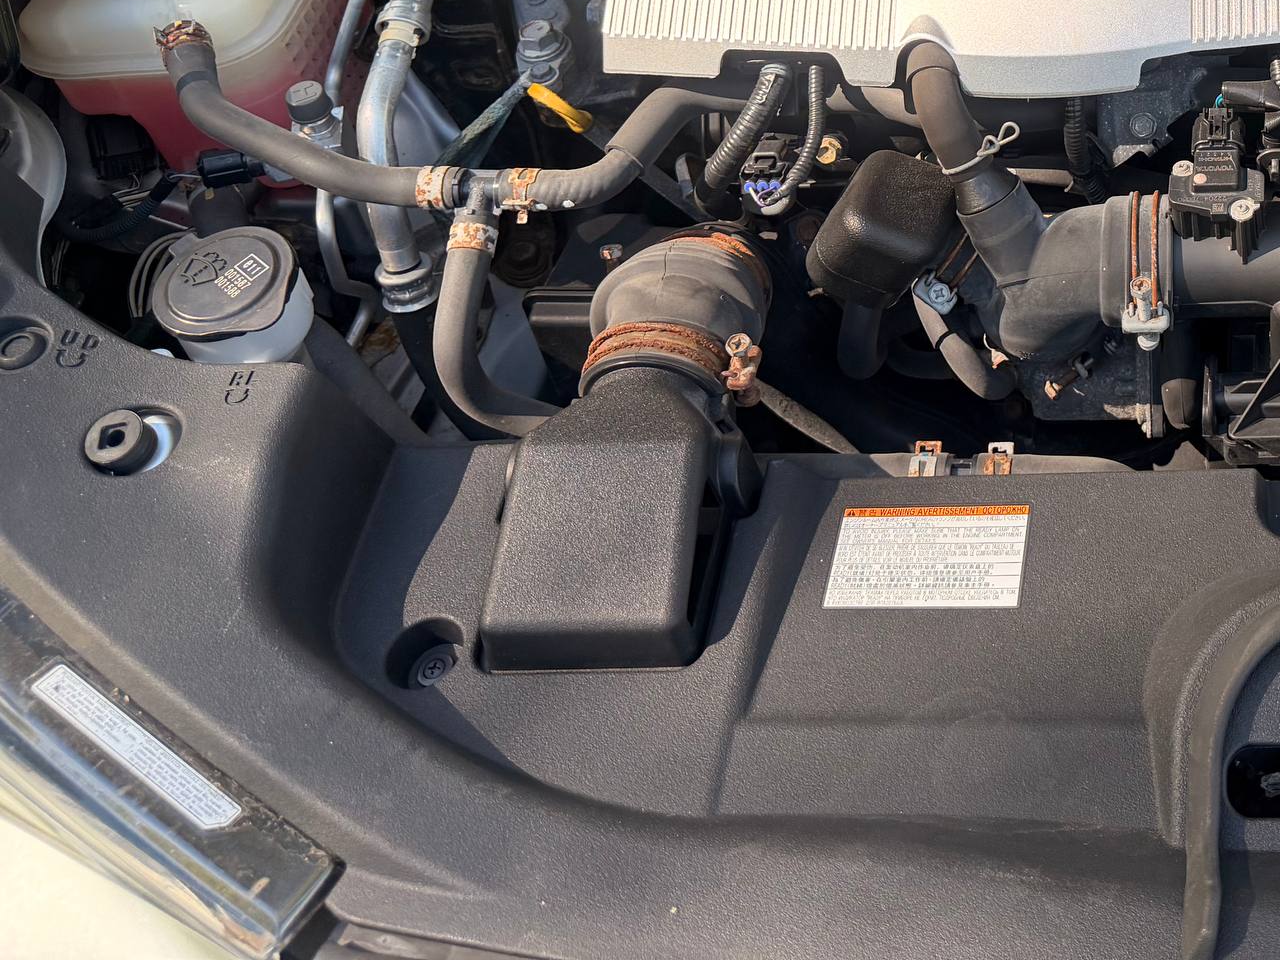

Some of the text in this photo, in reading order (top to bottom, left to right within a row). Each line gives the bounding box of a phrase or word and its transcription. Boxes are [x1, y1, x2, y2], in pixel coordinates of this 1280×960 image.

[242, 259, 262, 275] e11
[214, 276, 241, 298] 001588
[224, 268, 251, 290] 001587
[880, 506, 979, 516] WARNING AVERTISSEMENT
